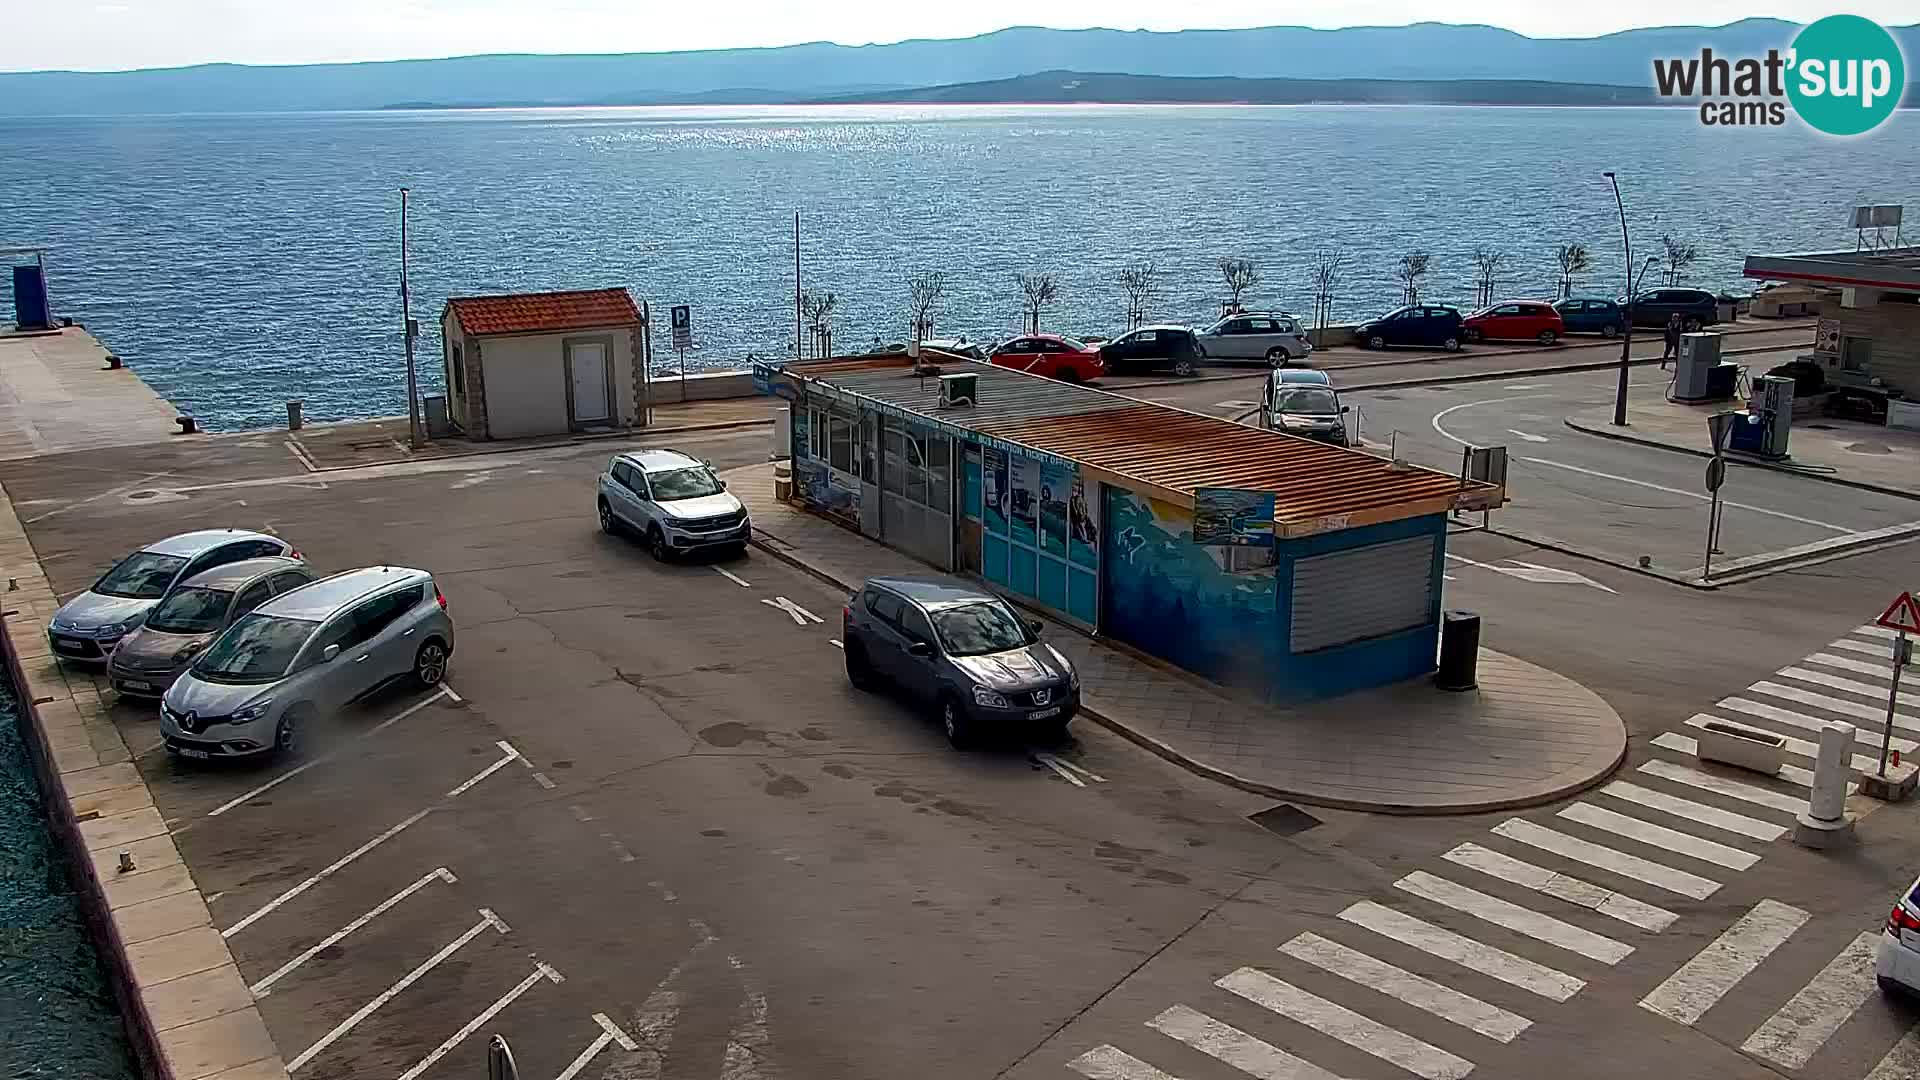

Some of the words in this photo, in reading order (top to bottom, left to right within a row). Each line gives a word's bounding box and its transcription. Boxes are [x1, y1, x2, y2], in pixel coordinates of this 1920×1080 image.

[675, 308, 686, 326] P
[977, 433, 992, 446] BUS
[993, 438, 1023, 456] STATION
[1024, 448, 1049, 464] TICKET
[1049, 454, 1076, 471] OFFICE
